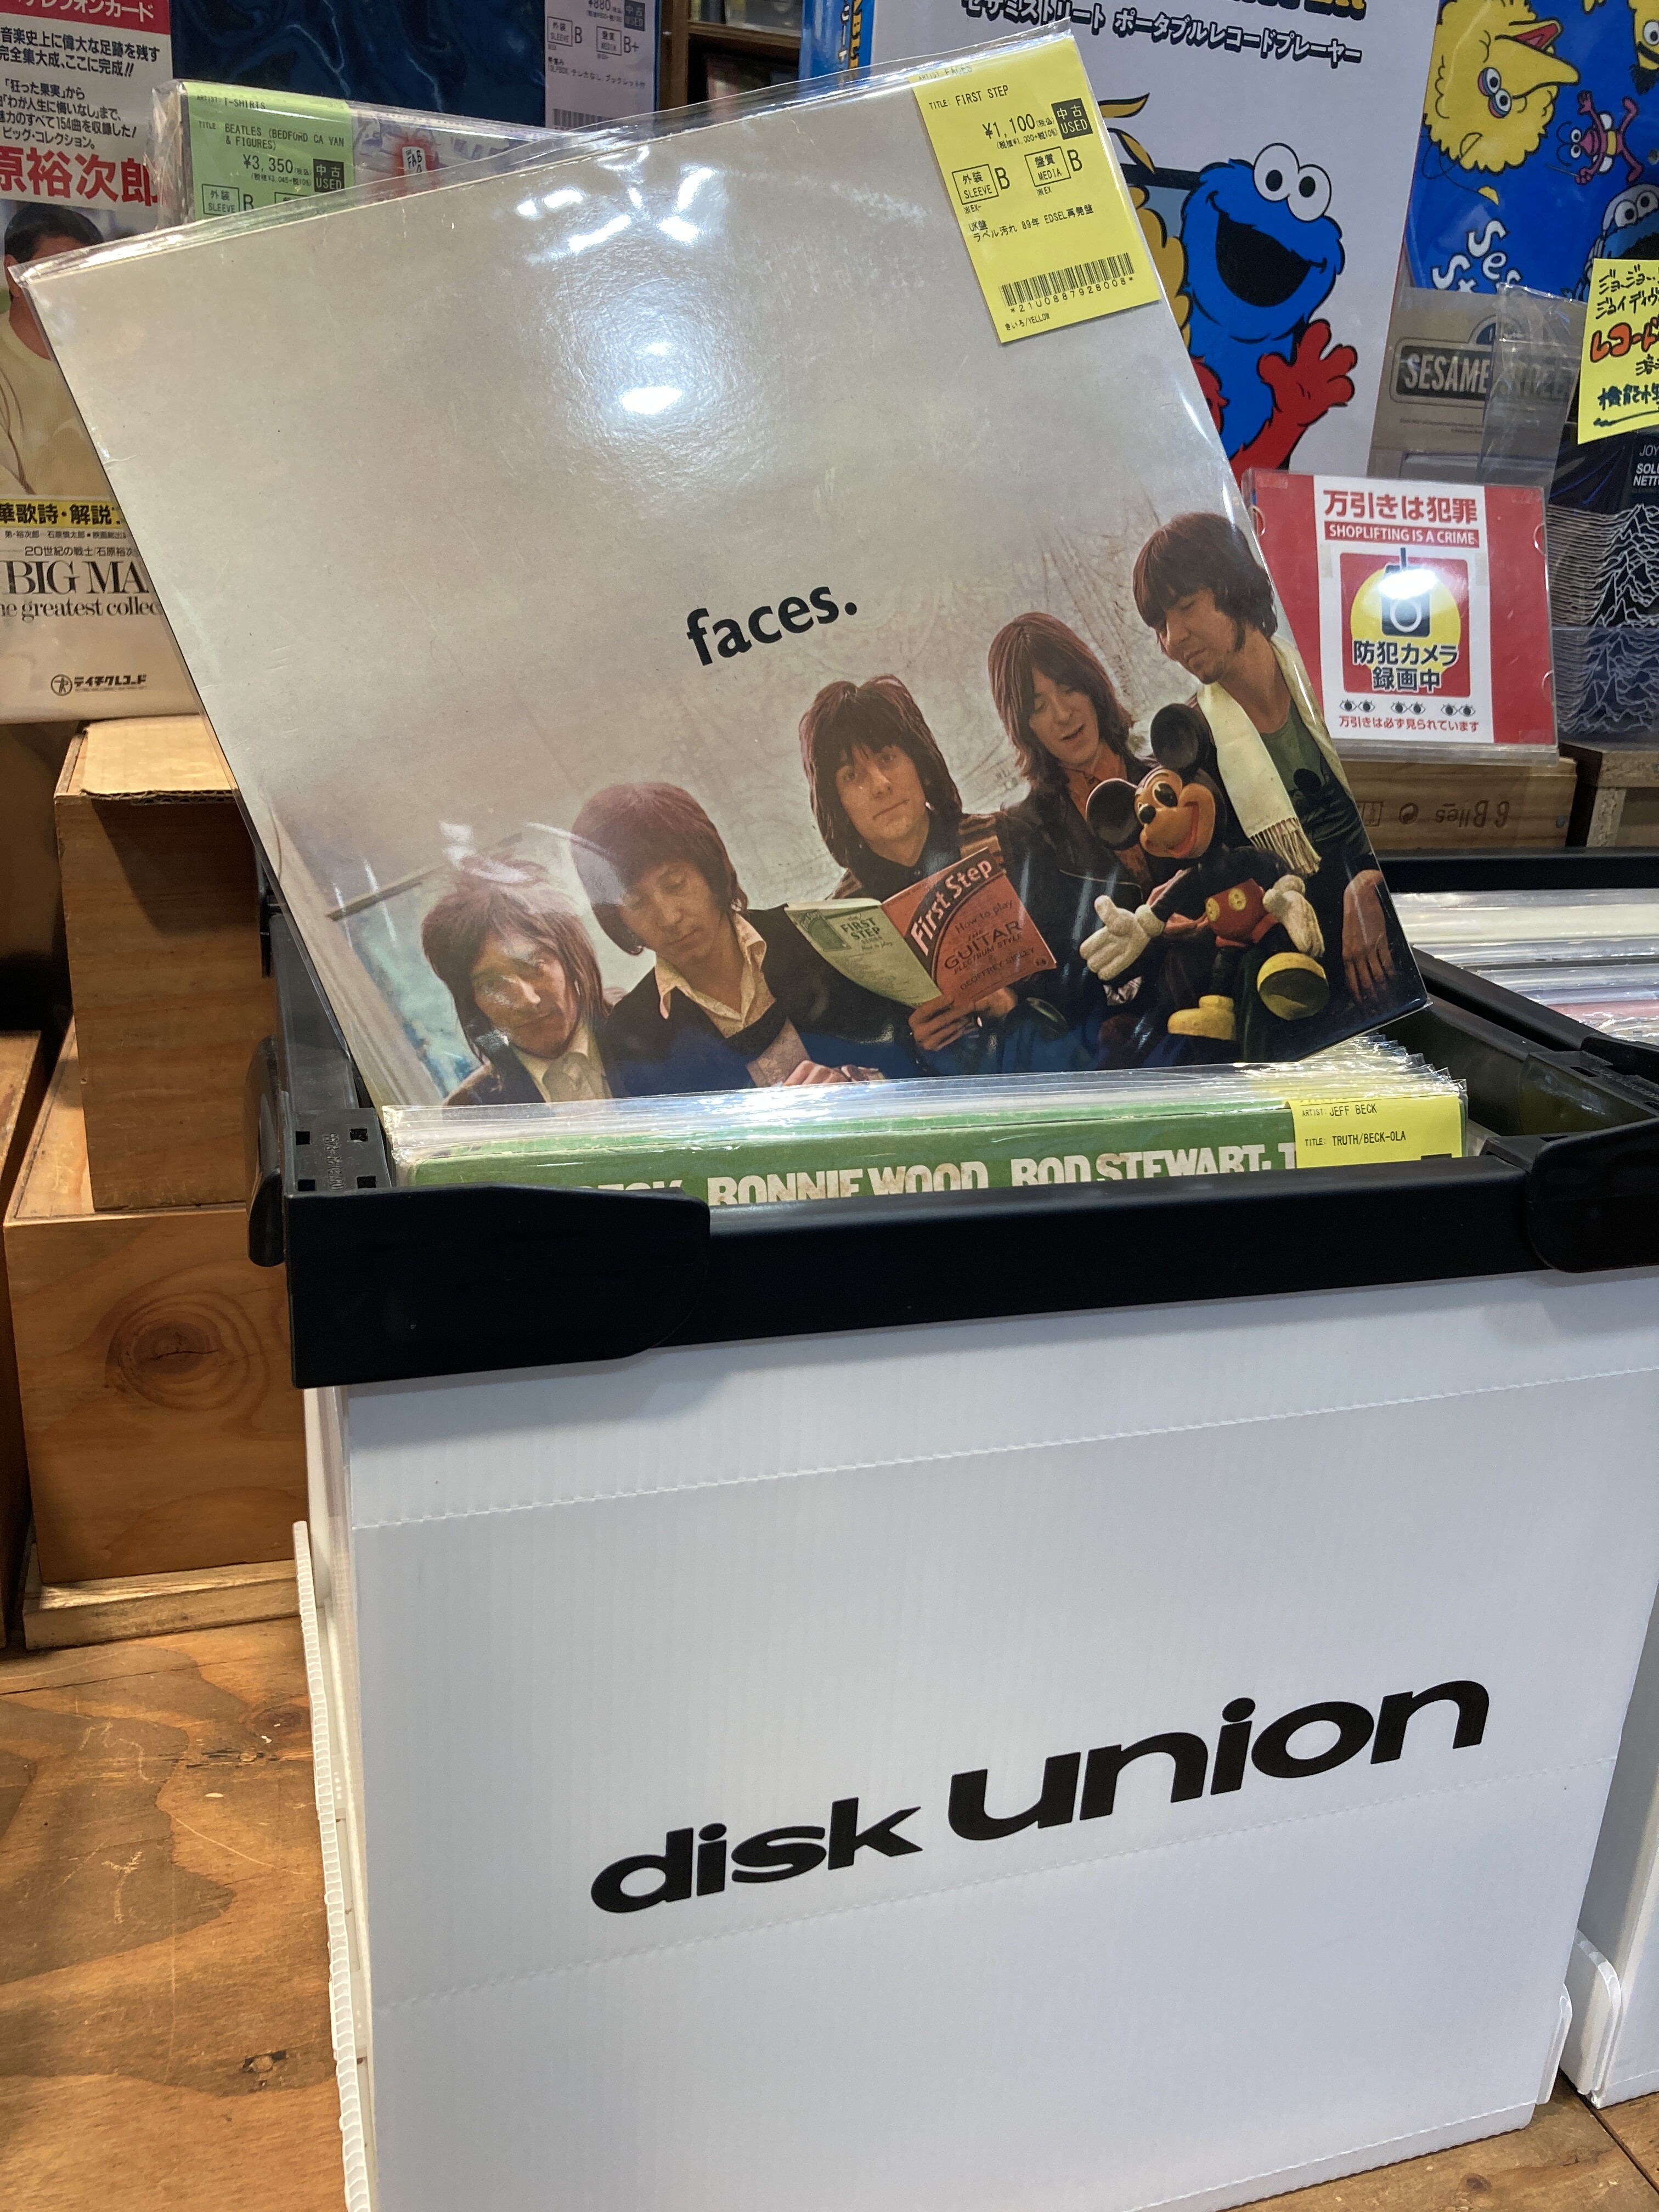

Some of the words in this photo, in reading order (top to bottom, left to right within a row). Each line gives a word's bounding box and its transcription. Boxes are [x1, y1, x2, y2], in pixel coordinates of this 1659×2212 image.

[574, 26, 583, 44] B
[623, 36, 639, 53] B+
[224, 97, 266, 109] T-SHIRTS
[955, 91, 982, 106] FIRST
[987, 84, 1008, 99] STEP
[1057, 104, 1082, 120] 中古
[225, 123, 262, 137] BEATLES
[268, 128, 308, 143] (BEDFORD
[329, 136, 344, 147] VAN
[1060, 119, 1088, 134] USED
[235, 136, 276, 151] FIGURES)
[316, 164, 341, 178] 中古
[1066, 149, 1083, 172] B
[315, 177, 342, 190] USED
[962, 170, 984, 185] 外装
[994, 166, 1011, 190] B
[1037, 167, 1062, 182] MEDIA
[963, 184, 992, 199] SLEEVE
[208, 202, 235, 213] SLEEVE
[973, 224, 1018, 242] ラベル汚れ
[1021, 218, 1040, 230] 89年
[1404, 353, 1491, 394] SESAME
[1323, 489, 1478, 525] 万引きは犯罪
[1329, 523, 1409, 541] SHOPLIFTING
[1412, 529, 1423, 541] IS
[1426, 531, 1435, 542] A
[1437, 531, 1475, 545] CRIME
[0, 560, 80, 595] BIG
[21, 597, 103, 623] greatest
[687, 586, 857, 666] faces.
[1353, 640, 1458, 667] 防犯カメラ
[1373, 666, 1441, 692] 録画中
[1339, 715, 1479, 733] 万引きは必ず見られています
[910, 891, 951, 956] First
[945, 859, 992, 898] Step
[955, 918, 978, 935] How
[980, 910, 991, 920] to
[993, 899, 1013, 916] play
[840, 917, 877, 933] FIRST
[850, 926, 881, 940] STEP
[944, 920, 1023, 970] GUITAR
[953, 946, 995, 975] PLECTRUM
[997, 933, 1023, 948] STYLE
[960, 962, 1002, 990] GEOFFREY
[1330, 1105, 1349, 1116] JEFF
[1356, 1103, 1378, 1114] BECK
[1332, 1131, 1406, 1147] TRUTH/BECK-OLA
[590, 1797, 923, 1914] disk
[947, 1678, 1491, 1841] union
